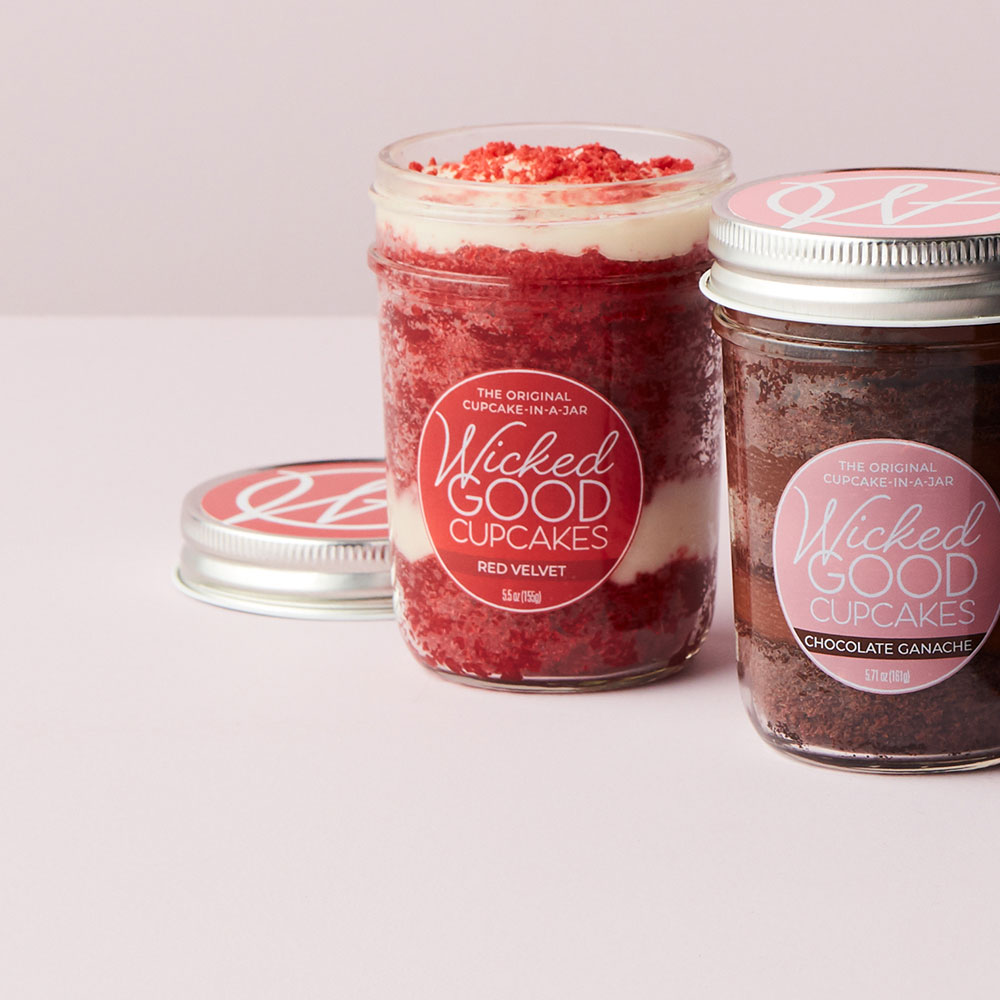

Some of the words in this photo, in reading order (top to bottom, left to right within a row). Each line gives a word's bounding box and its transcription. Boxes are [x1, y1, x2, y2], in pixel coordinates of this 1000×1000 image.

[462, 400, 588, 415] CUPCAKE-IN-A-JAR
[477, 387, 502, 399] THE
[506, 390, 571, 402] ORIGINAL
[434, 410, 619, 489] Wicked
[838, 460, 865, 473] THE
[869, 462, 937, 474] ORIGINAL
[823, 473, 954, 488] CUPCAKE-IN-A-JAR
[447, 473, 611, 523] GOOD
[449, 518, 608, 551] CUPCAKES
[793, 486, 986, 566] Wicked
[477, 560, 508, 575] RED
[511, 564, 567, 577] VELVET
[808, 550, 978, 599] GOOD
[809, 597, 976, 628] CUPCAKES
[804, 634, 894, 655] CHOCOLATE
[897, 639, 973, 655] GANACHE
